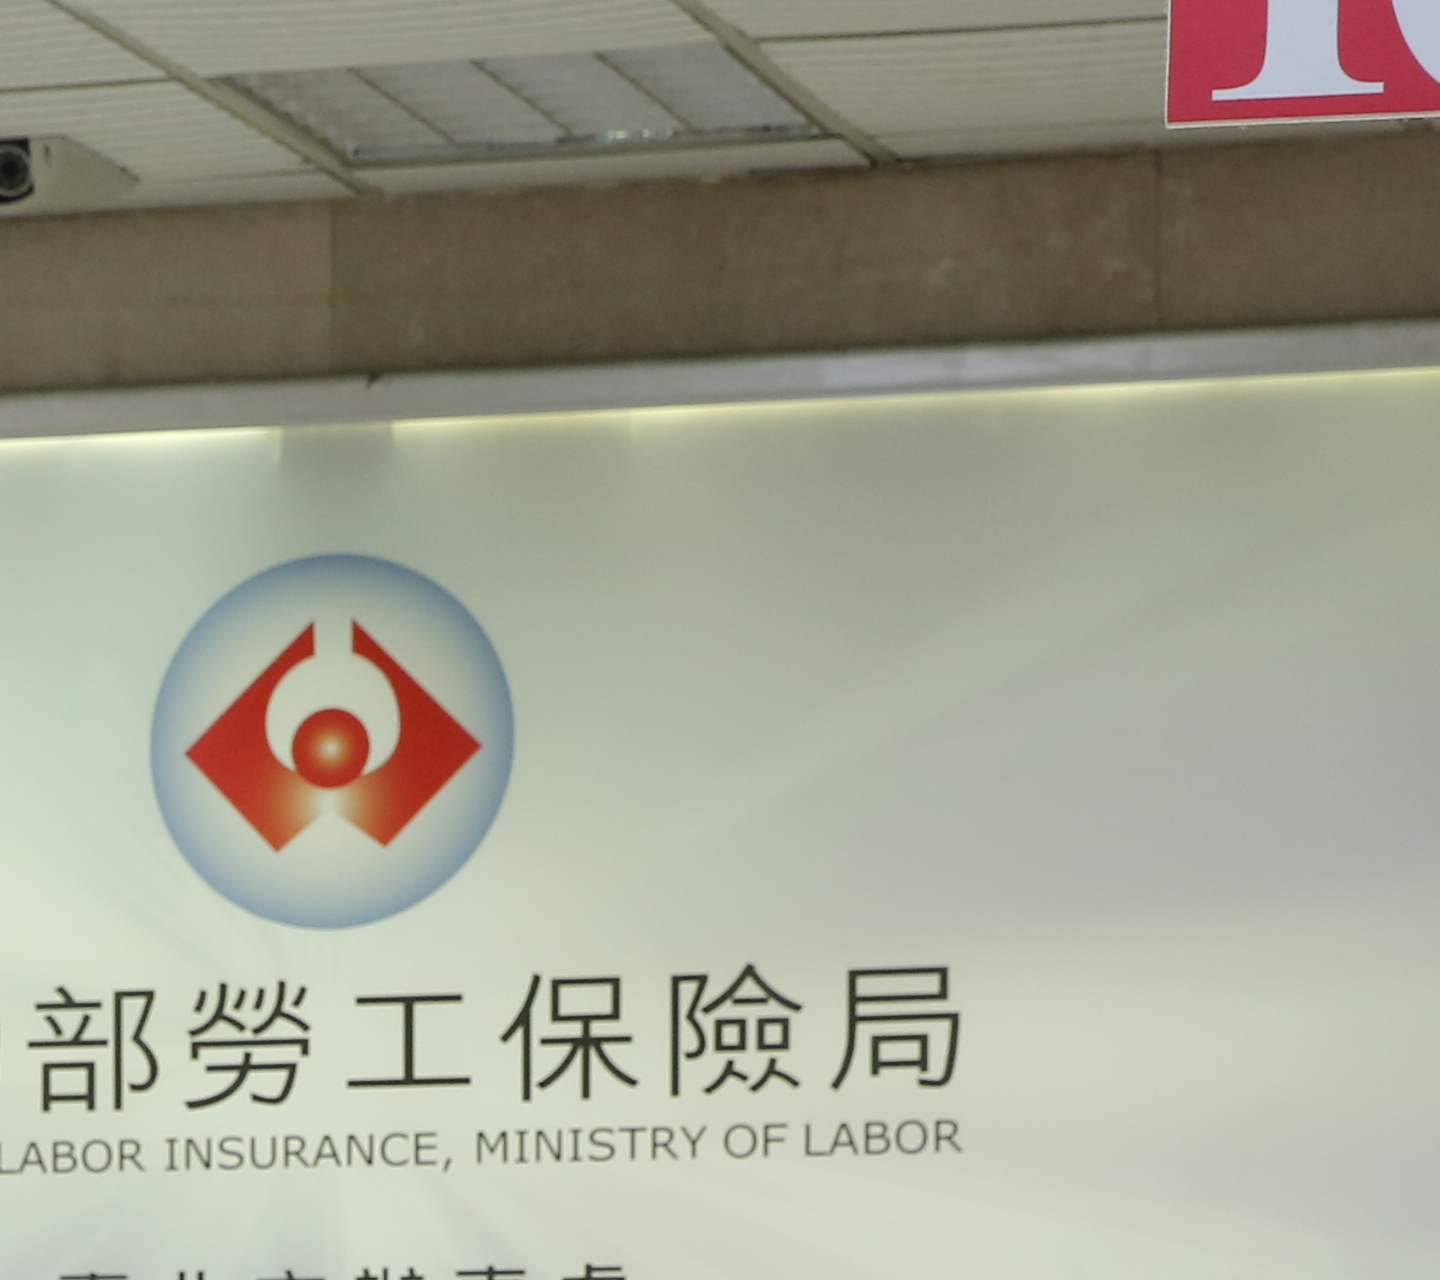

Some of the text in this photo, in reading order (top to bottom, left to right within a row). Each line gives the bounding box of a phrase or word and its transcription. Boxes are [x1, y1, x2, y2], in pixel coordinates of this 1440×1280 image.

[165, 1131, 453, 1172] INSURANCE,
[475, 1125, 707, 1165] MINISTRY
[724, 1122, 789, 1159] OF
[803, 1118, 963, 1157] LABOR
